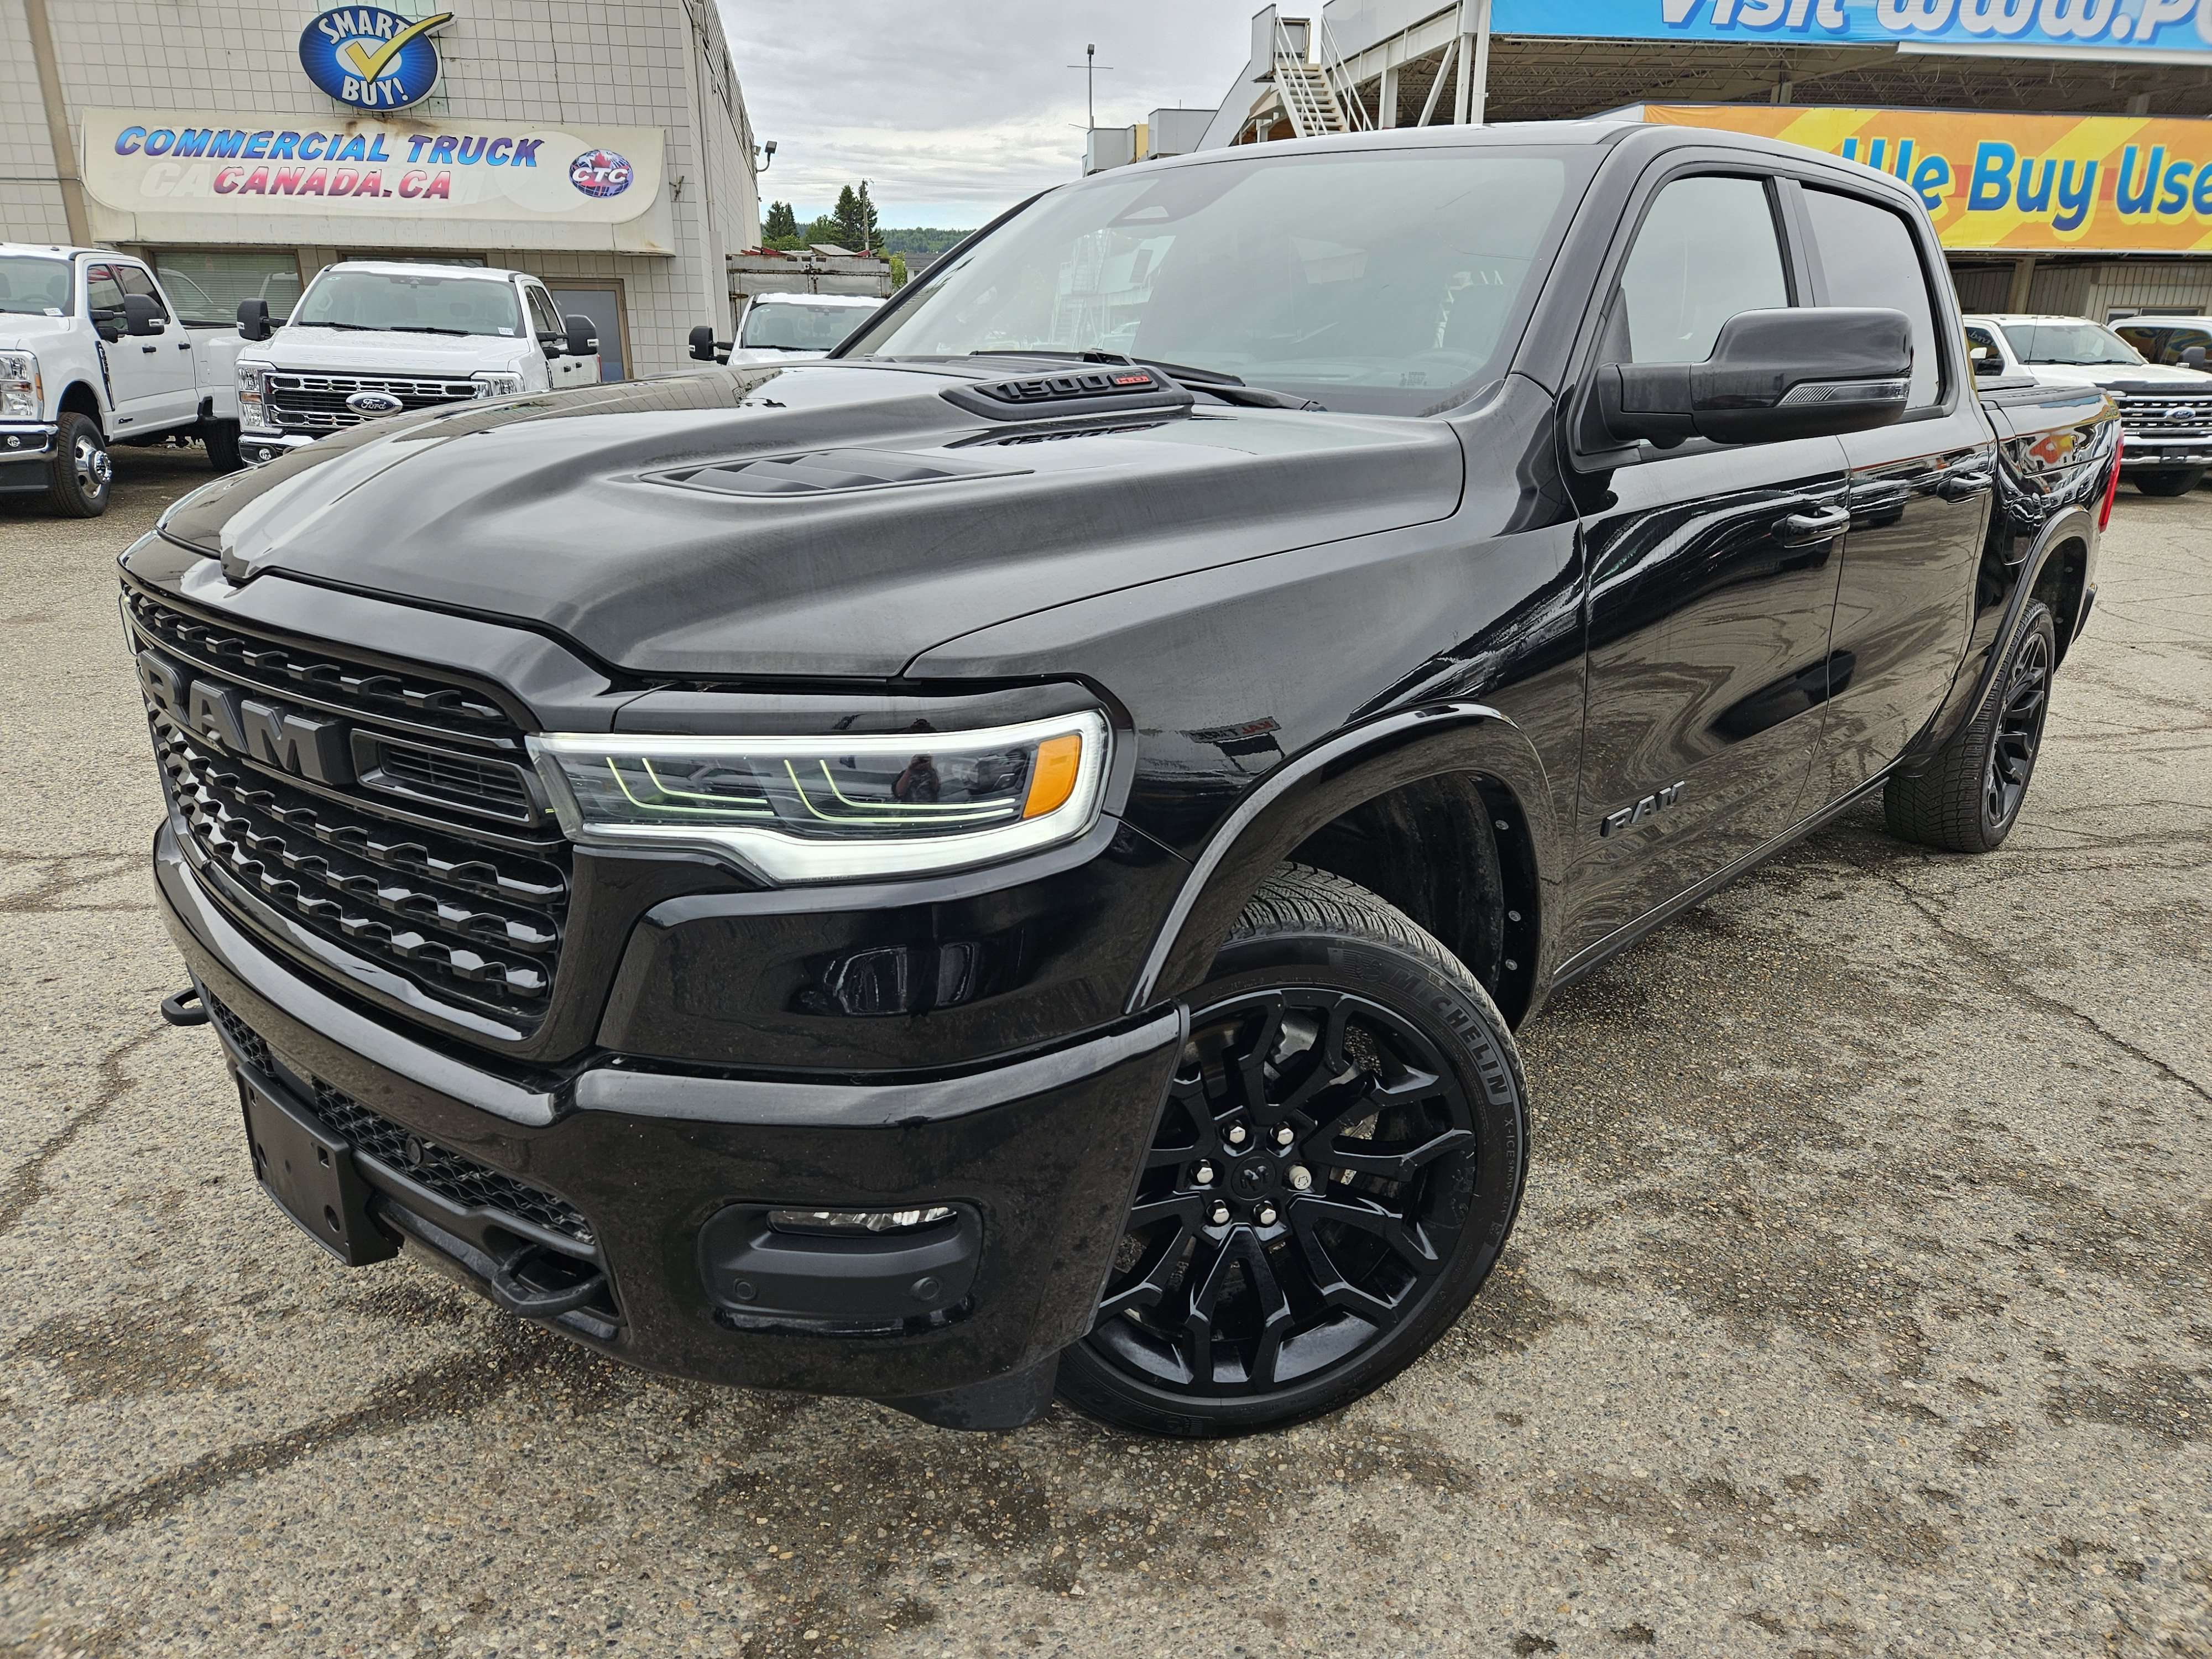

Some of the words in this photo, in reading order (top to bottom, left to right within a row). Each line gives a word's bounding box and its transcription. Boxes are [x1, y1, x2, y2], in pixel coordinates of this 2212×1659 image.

[318, 10, 410, 44] SMART
[342, 75, 409, 106] BUY!
[114, 126, 389, 161] COMMERCIAL
[406, 134, 544, 168] TRUCK
[213, 166, 451, 200] CANADA.CA
[572, 166, 628, 183] CTC
[1967, 142, 2100, 231] Buy
[2116, 145, 2212, 215] Use
[361, 398, 387, 410] Ford
[997, 375, 1108, 399] 1500
[138, 649, 346, 785] RAM
[1600, 780, 1686, 837] RAM
[1387, 972, 1509, 1097] MICHELIN
